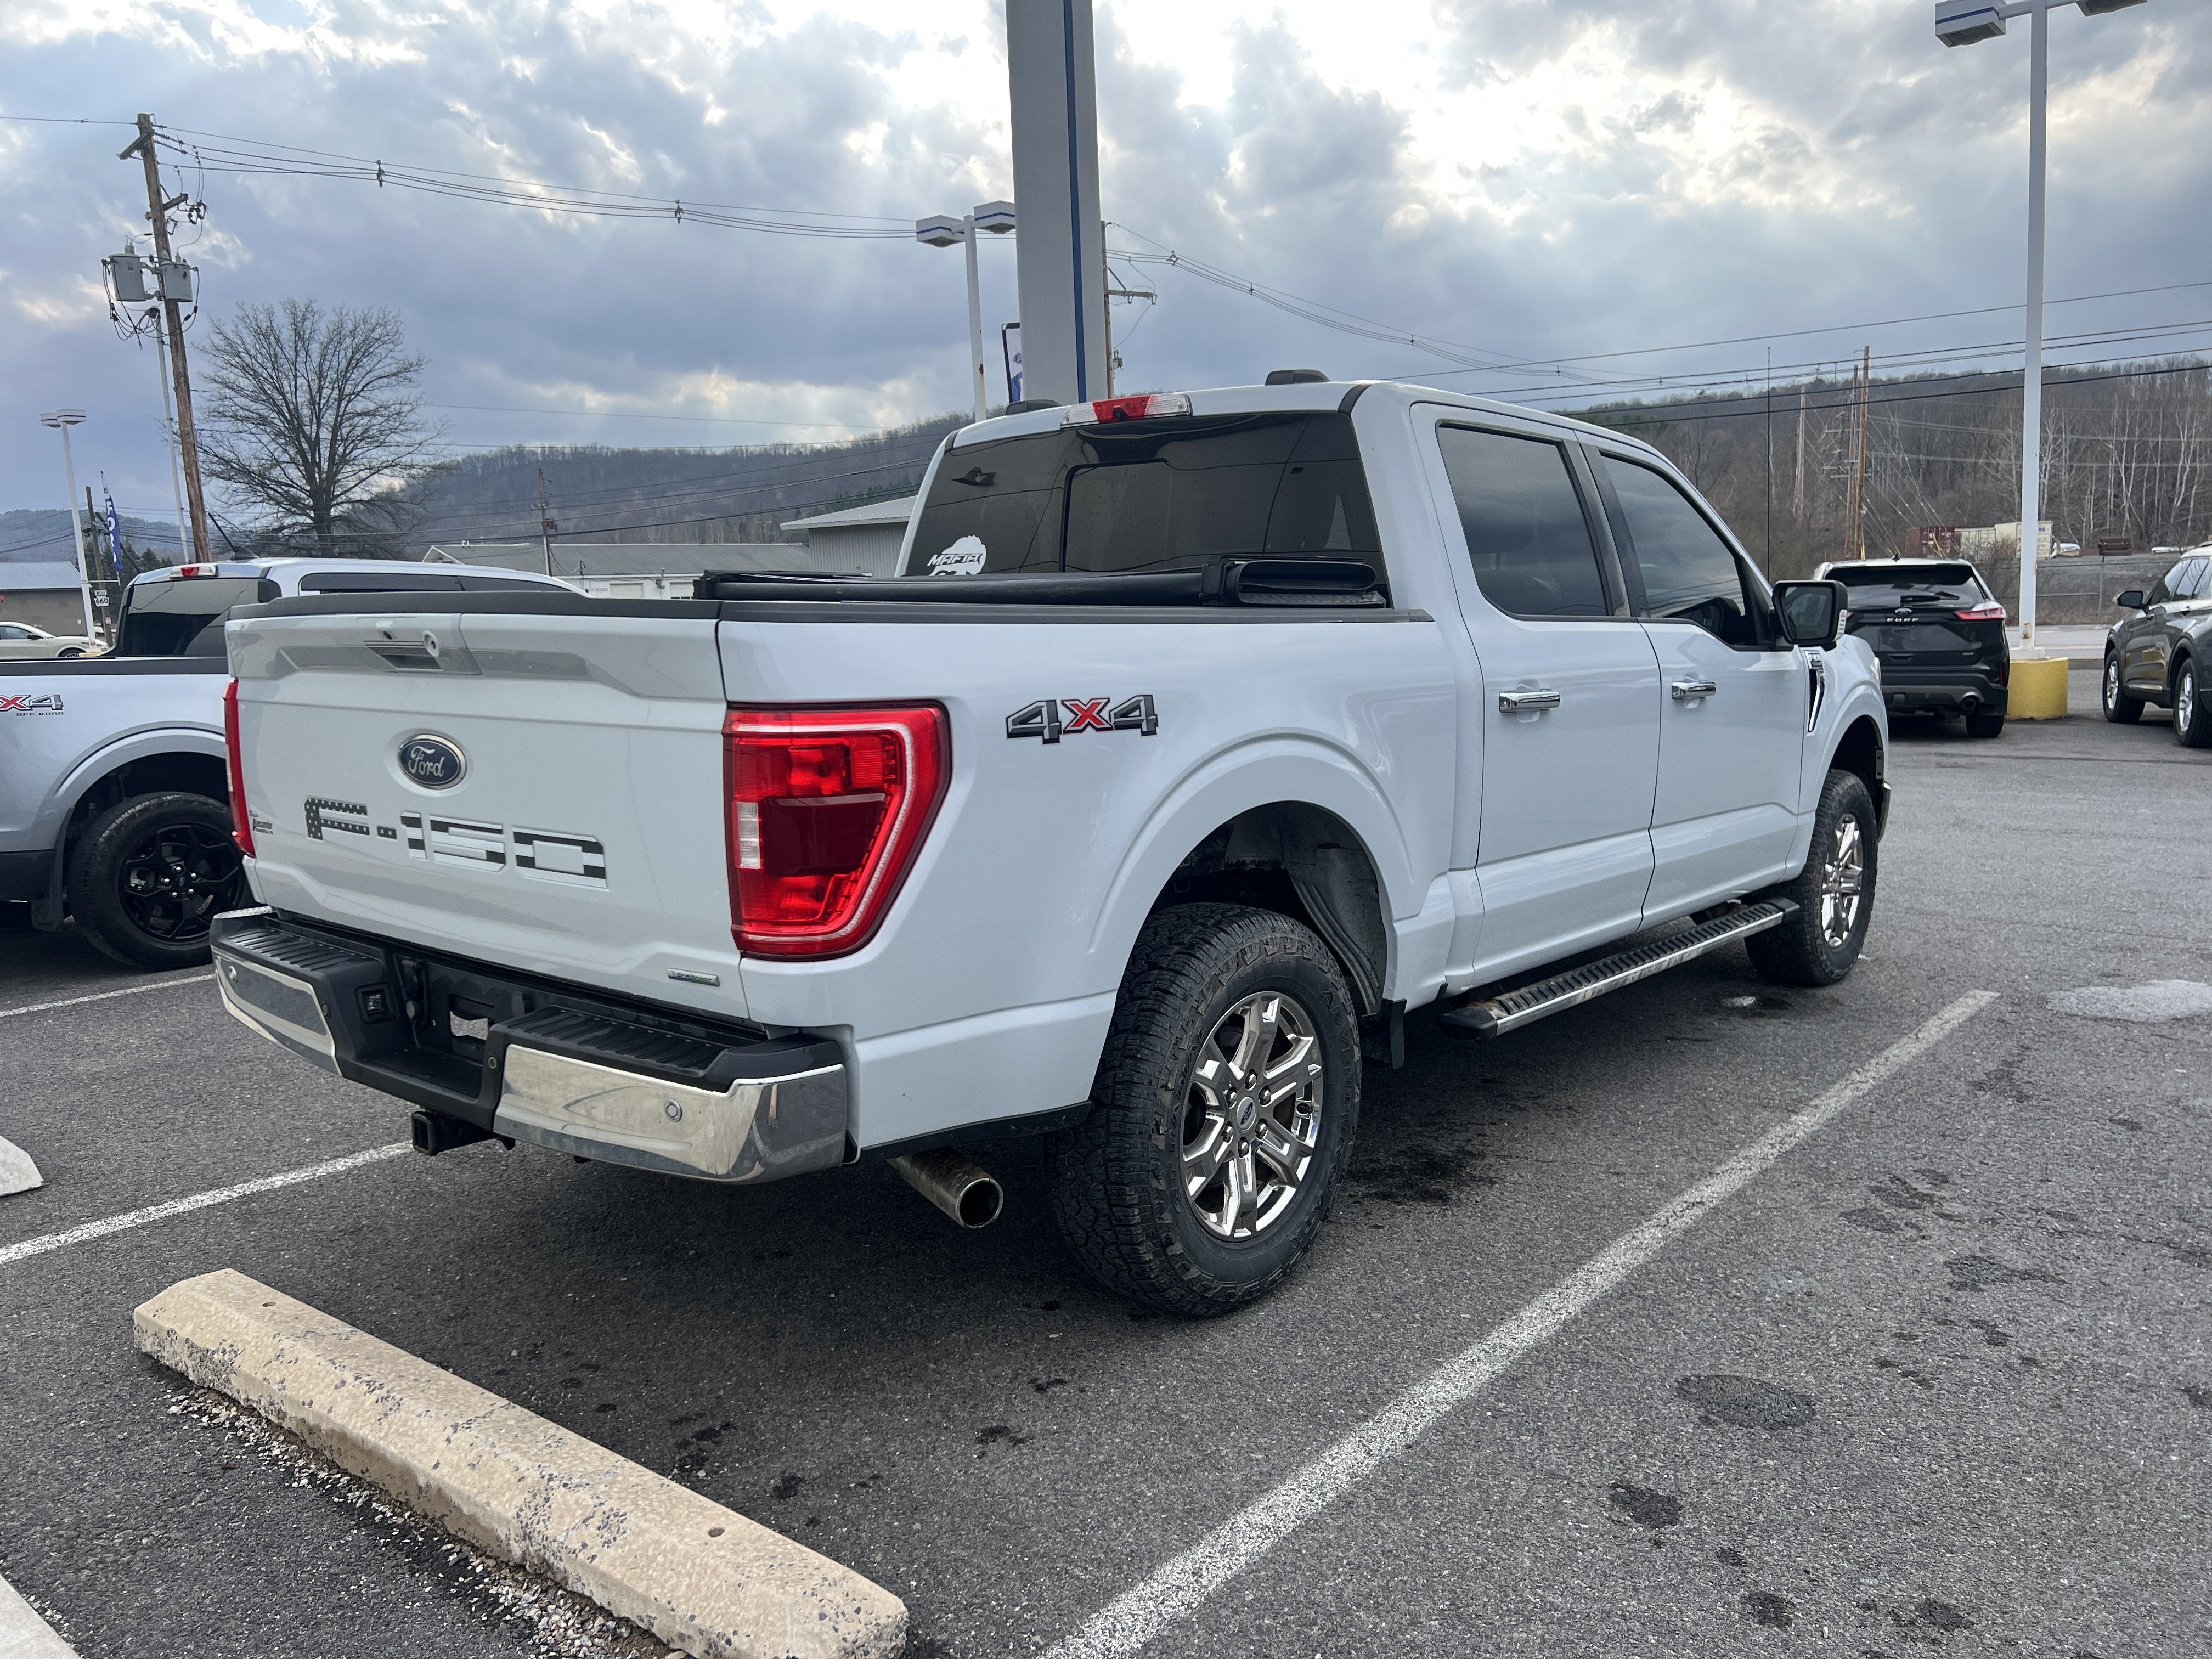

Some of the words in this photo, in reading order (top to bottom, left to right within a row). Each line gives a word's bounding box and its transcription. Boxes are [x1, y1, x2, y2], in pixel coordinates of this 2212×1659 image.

[927, 554, 980, 567] MAFIA
[0, 694, 64, 712] X4
[1006, 695, 1159, 745] 4X4
[408, 746, 445, 777] Ford
[304, 796, 608, 890] F-150
[1319, 990, 1354, 1187] ADVENTURO
